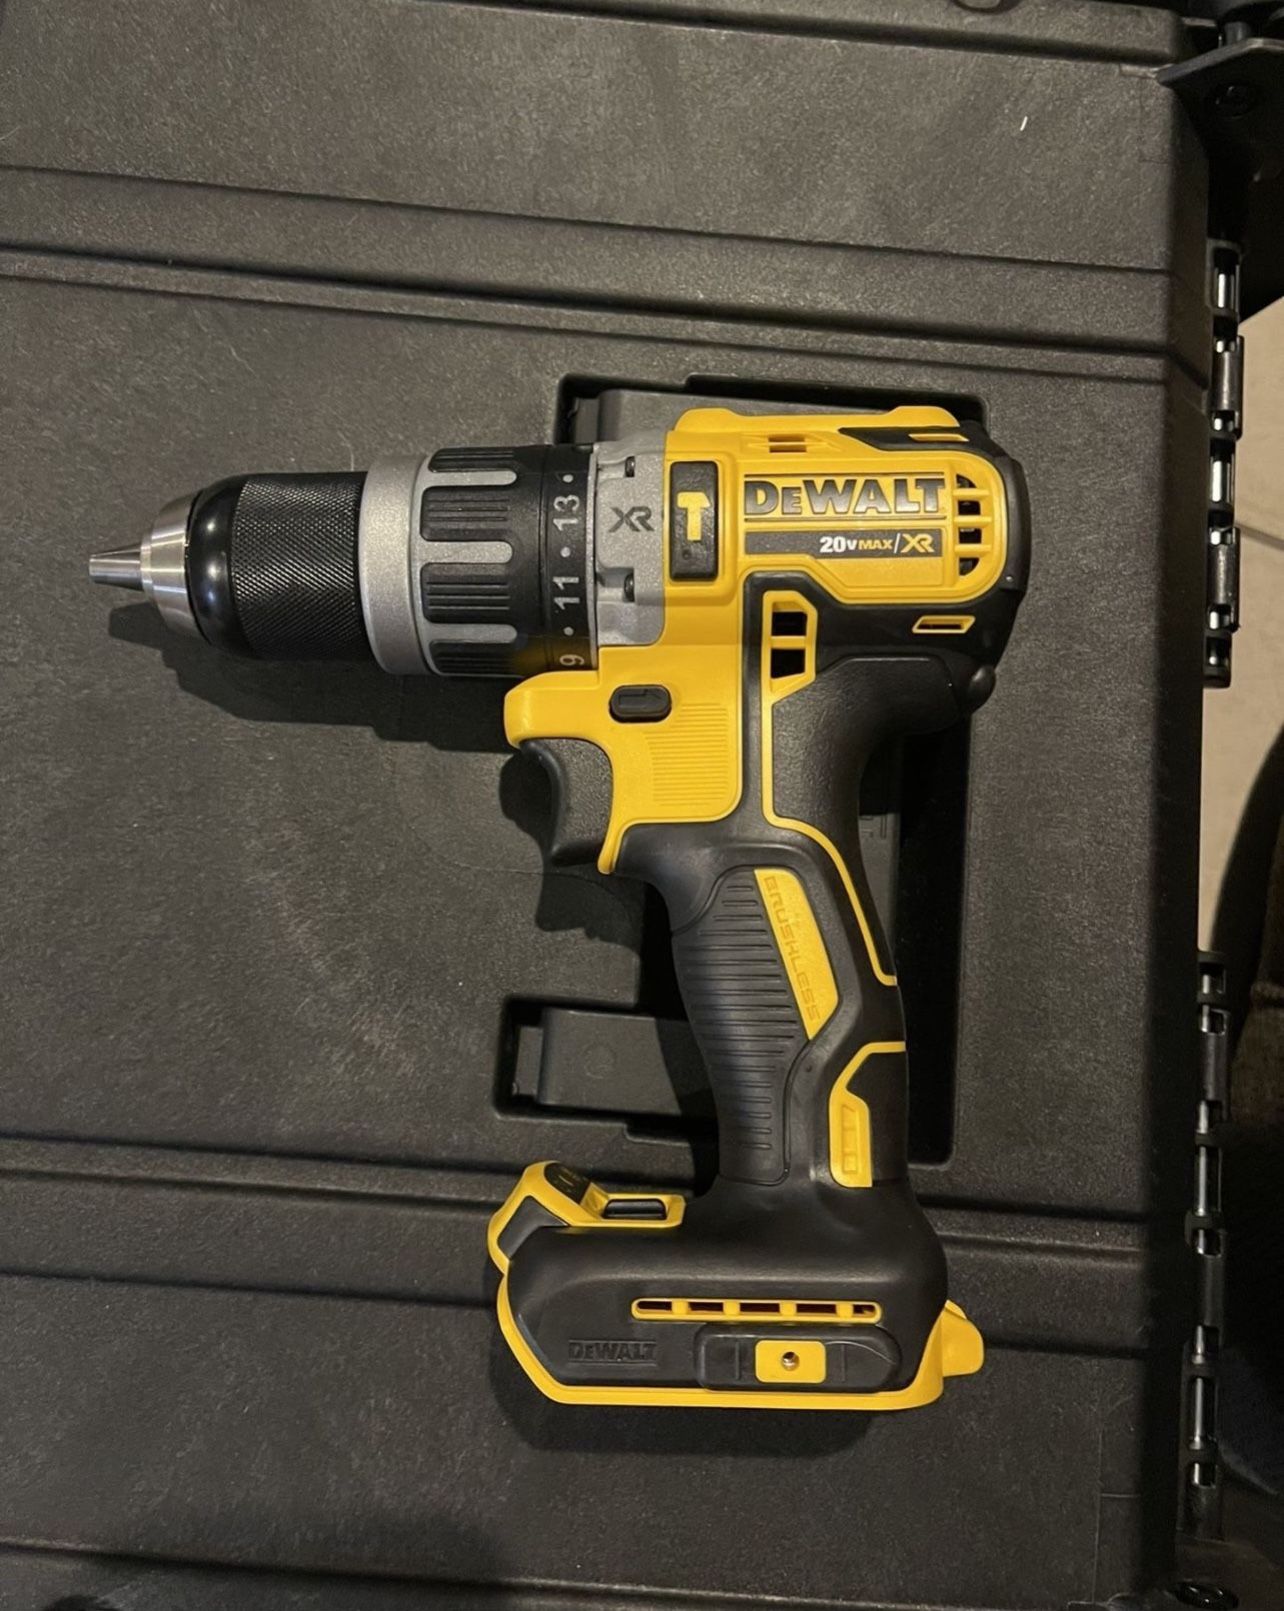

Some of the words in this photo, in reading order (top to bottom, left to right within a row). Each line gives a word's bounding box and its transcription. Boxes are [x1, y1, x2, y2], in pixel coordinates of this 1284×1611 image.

[553, 494, 580, 531] 13
[608, 506, 655, 533] XR
[553, 576, 580, 610] 11
[764, 875, 821, 1021] BRUSHLESS
